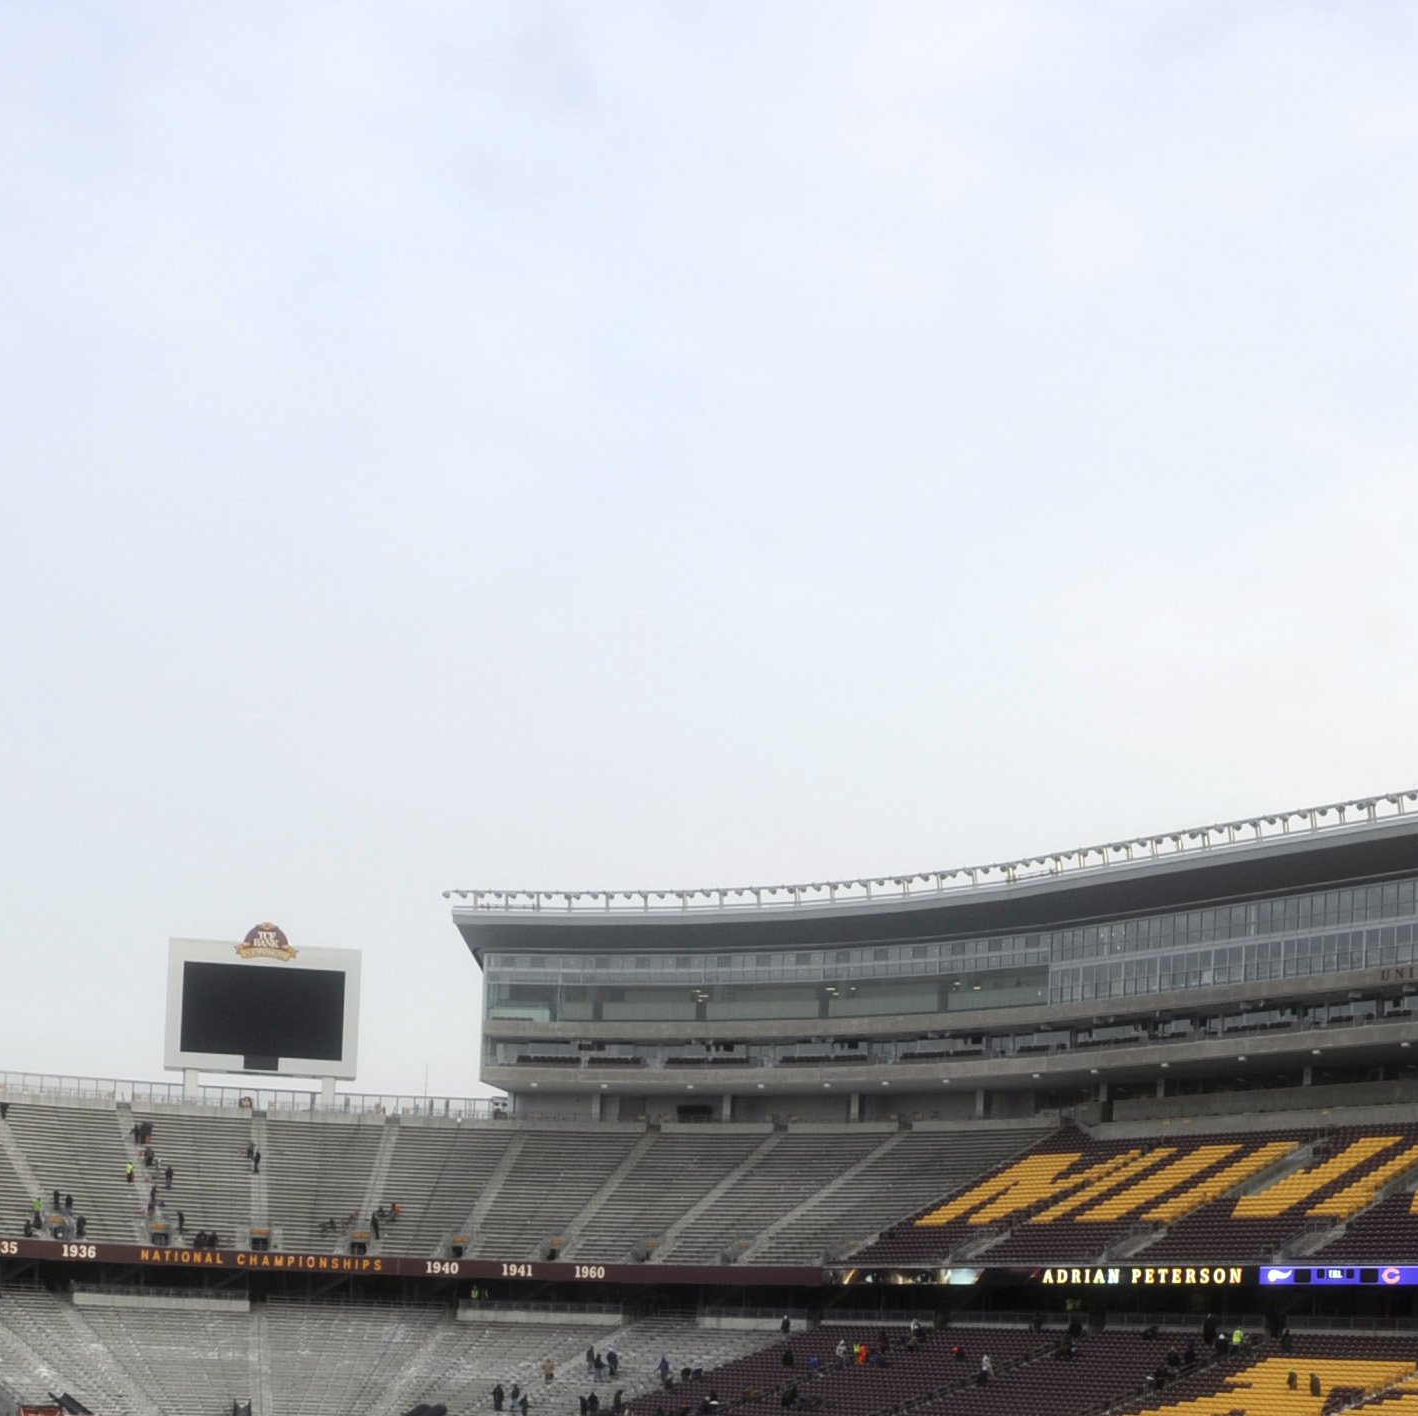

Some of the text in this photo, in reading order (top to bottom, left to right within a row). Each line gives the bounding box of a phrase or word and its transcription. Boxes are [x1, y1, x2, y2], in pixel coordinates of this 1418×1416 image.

[253, 938, 279, 949] BANK
[62, 1244, 97, 1259] 1936
[141, 1249, 383, 1271] NATIONAL CHAMPIONSHIPS
[426, 1261, 605, 1279] 1940 1941 1960
[1042, 1268, 1243, 1285] ADRIAN PETERSON
